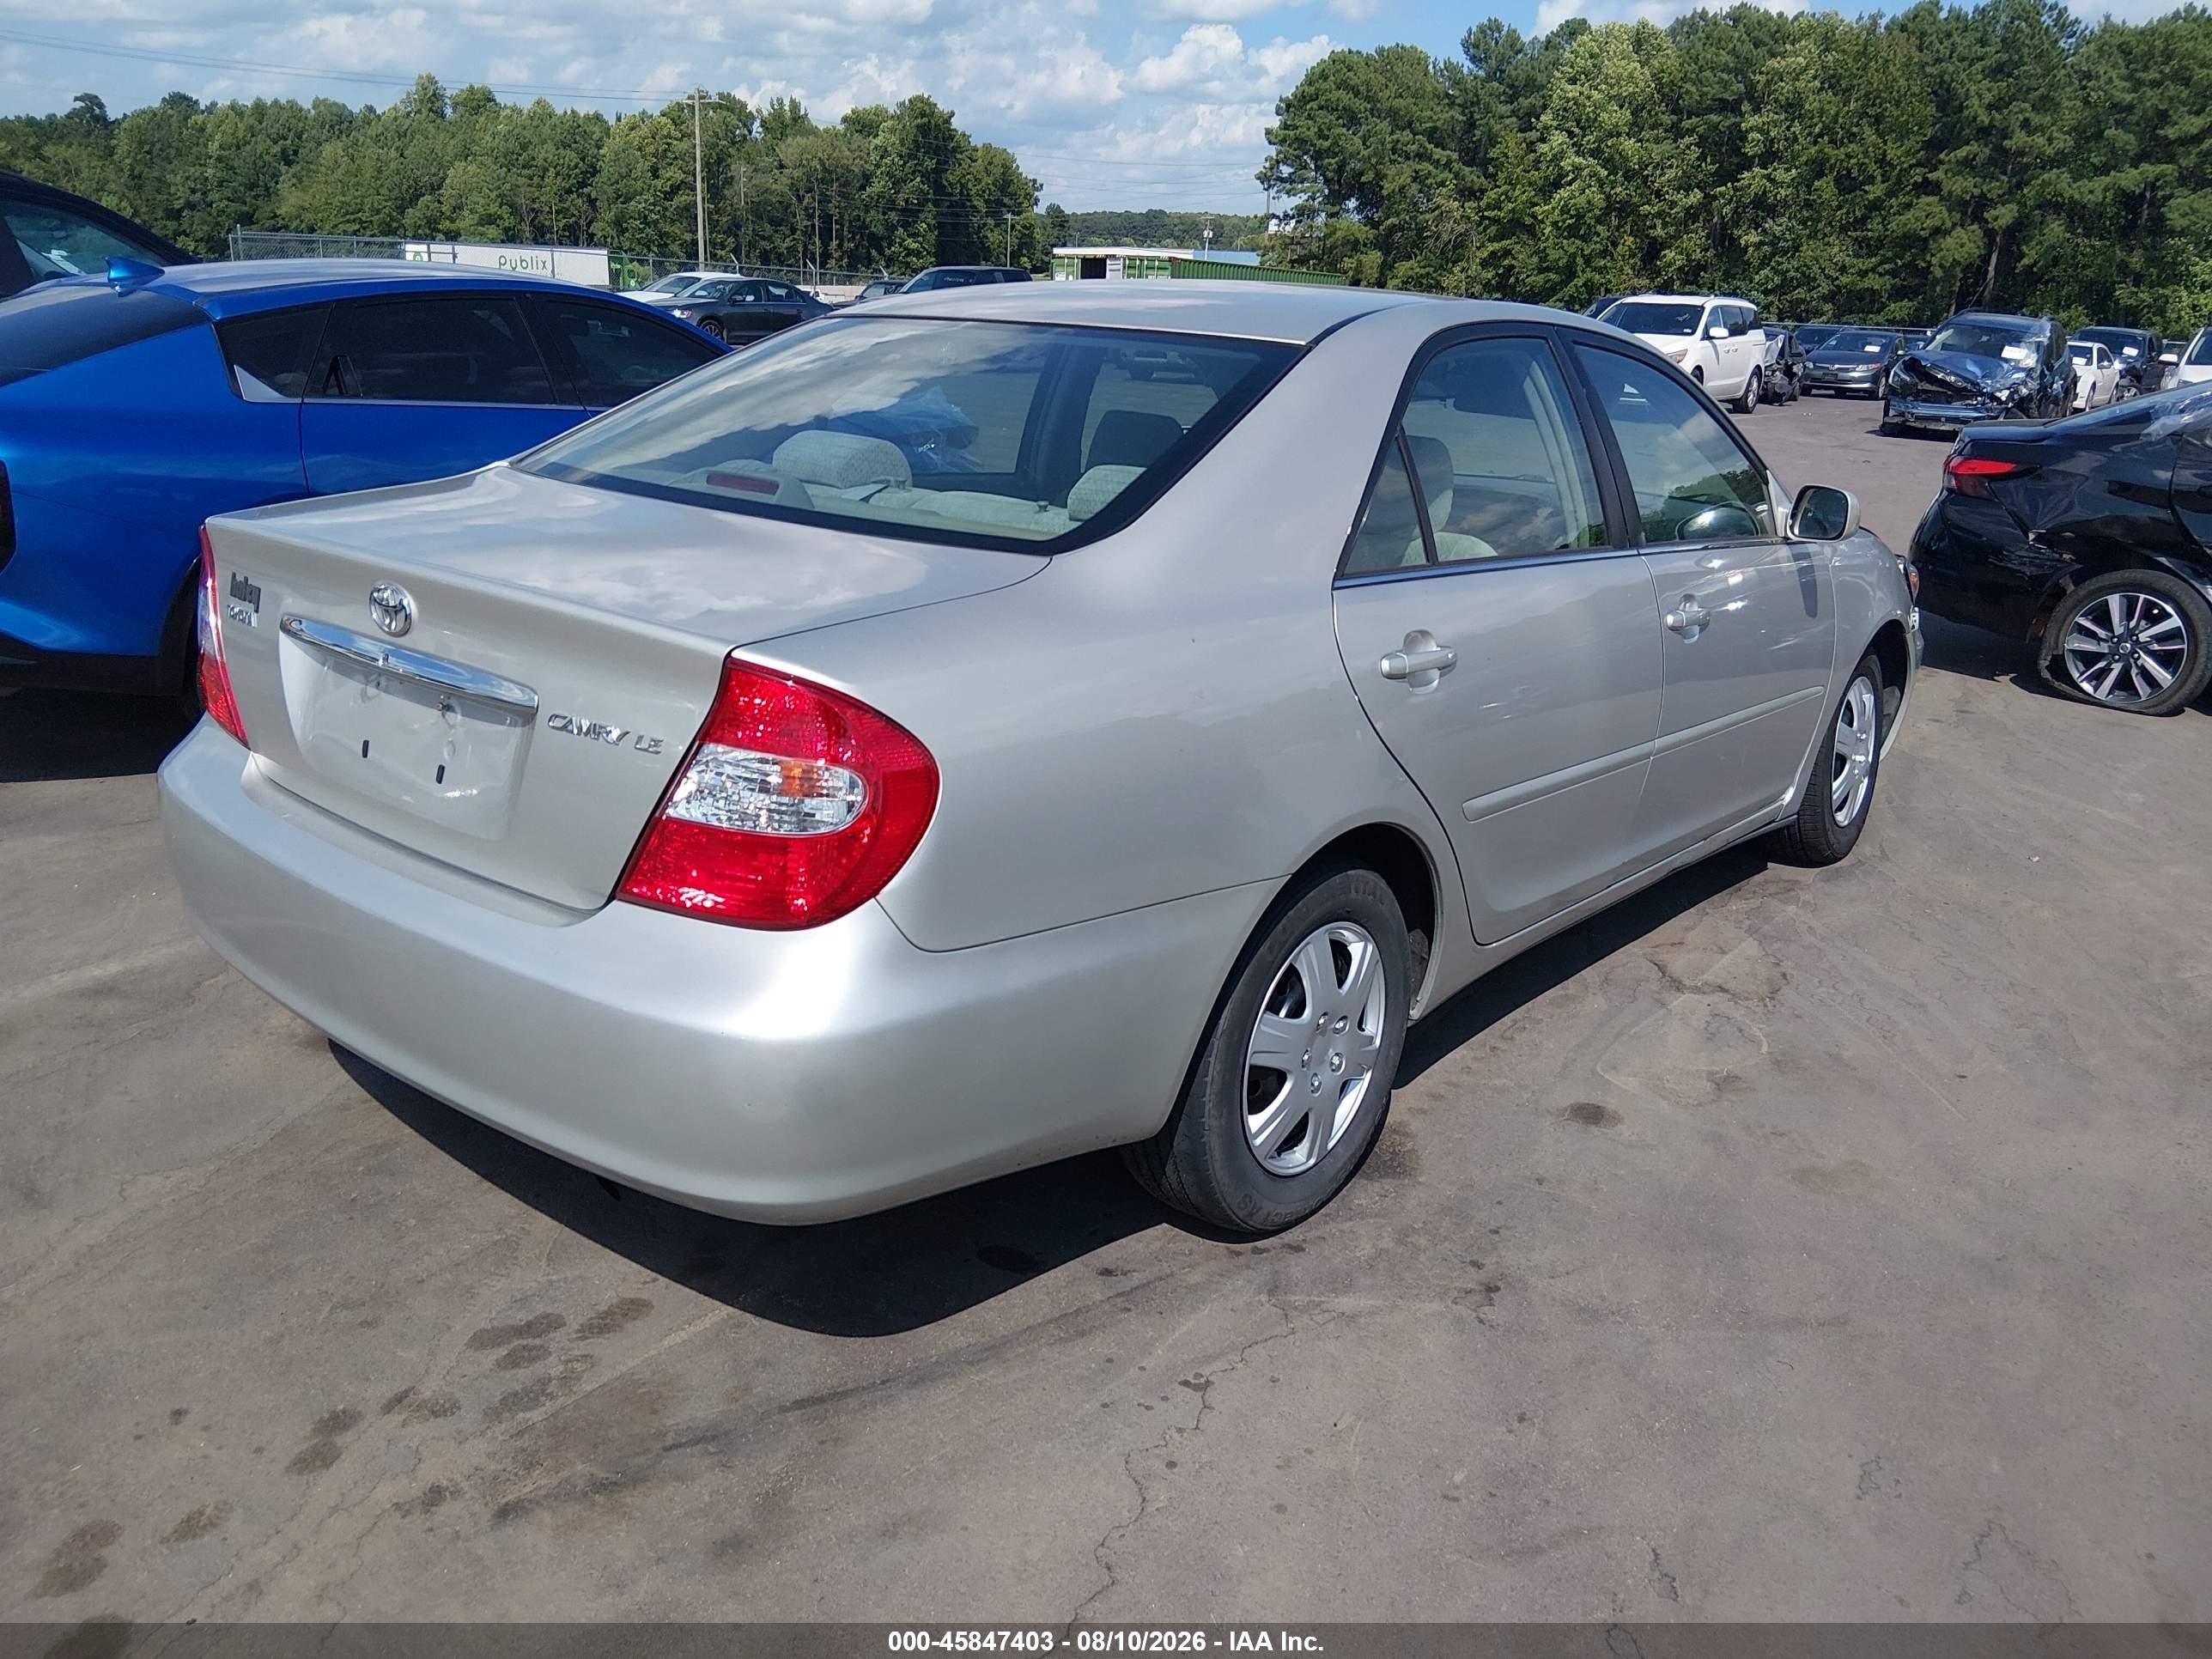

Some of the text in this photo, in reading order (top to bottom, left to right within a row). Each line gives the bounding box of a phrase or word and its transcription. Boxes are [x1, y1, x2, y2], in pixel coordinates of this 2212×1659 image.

[498, 255, 547, 270] Publix
[548, 714, 664, 755] CAMRY LE
